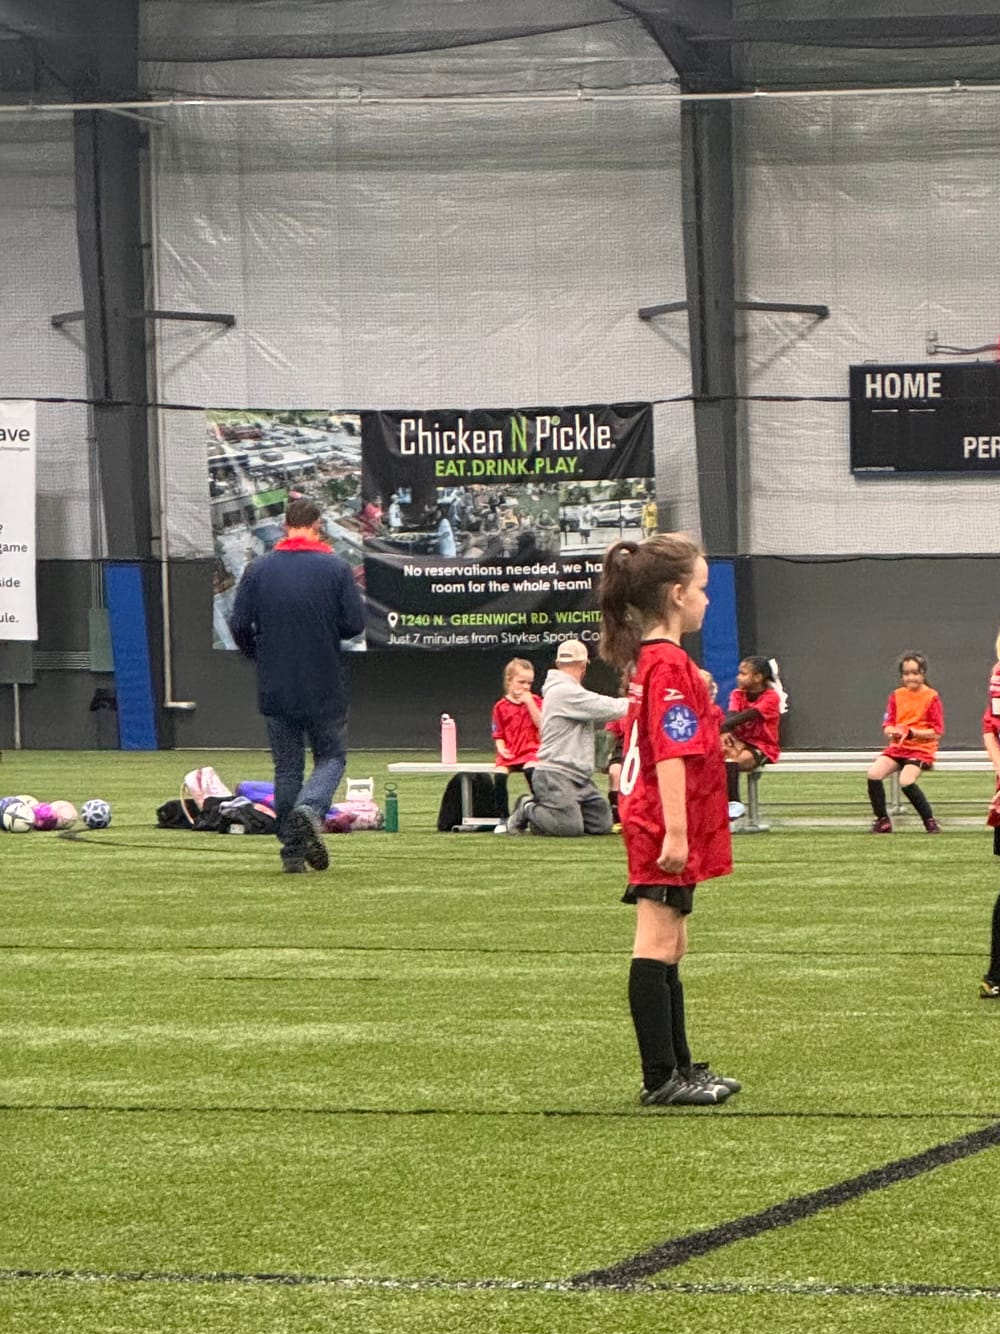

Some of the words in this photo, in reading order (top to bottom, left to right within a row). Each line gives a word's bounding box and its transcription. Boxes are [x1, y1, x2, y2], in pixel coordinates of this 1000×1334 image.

[865, 373, 942, 399] HOME
[400, 417, 503, 455] Chicken
[511, 417, 527, 452] N
[404, 565, 422, 577] No
[425, 564, 502, 577] reservations
[506, 562, 559, 576] needed,
[563, 563, 582, 573] we
[585, 561, 603, 573] ha
[0, 577, 21, 588] ide
[431, 582, 464, 593] room
[468, 580, 485, 592] for
[489, 580, 510, 593] the
[513, 579, 551, 592] whole
[553, 578, 592, 591] team!
[400, 614, 430, 626] 1240
[433, 614, 447, 626] N.
[450, 612, 527, 625] GREENWICH
[531, 611, 552, 624] RD.
[387, 633, 411, 645] Just
[413, 634, 420, 644] 7
[423, 632, 469, 645] minutes
[471, 631, 499, 644] from
[501, 630, 541, 645] Stryker
[543, 630, 579, 644] Sports
